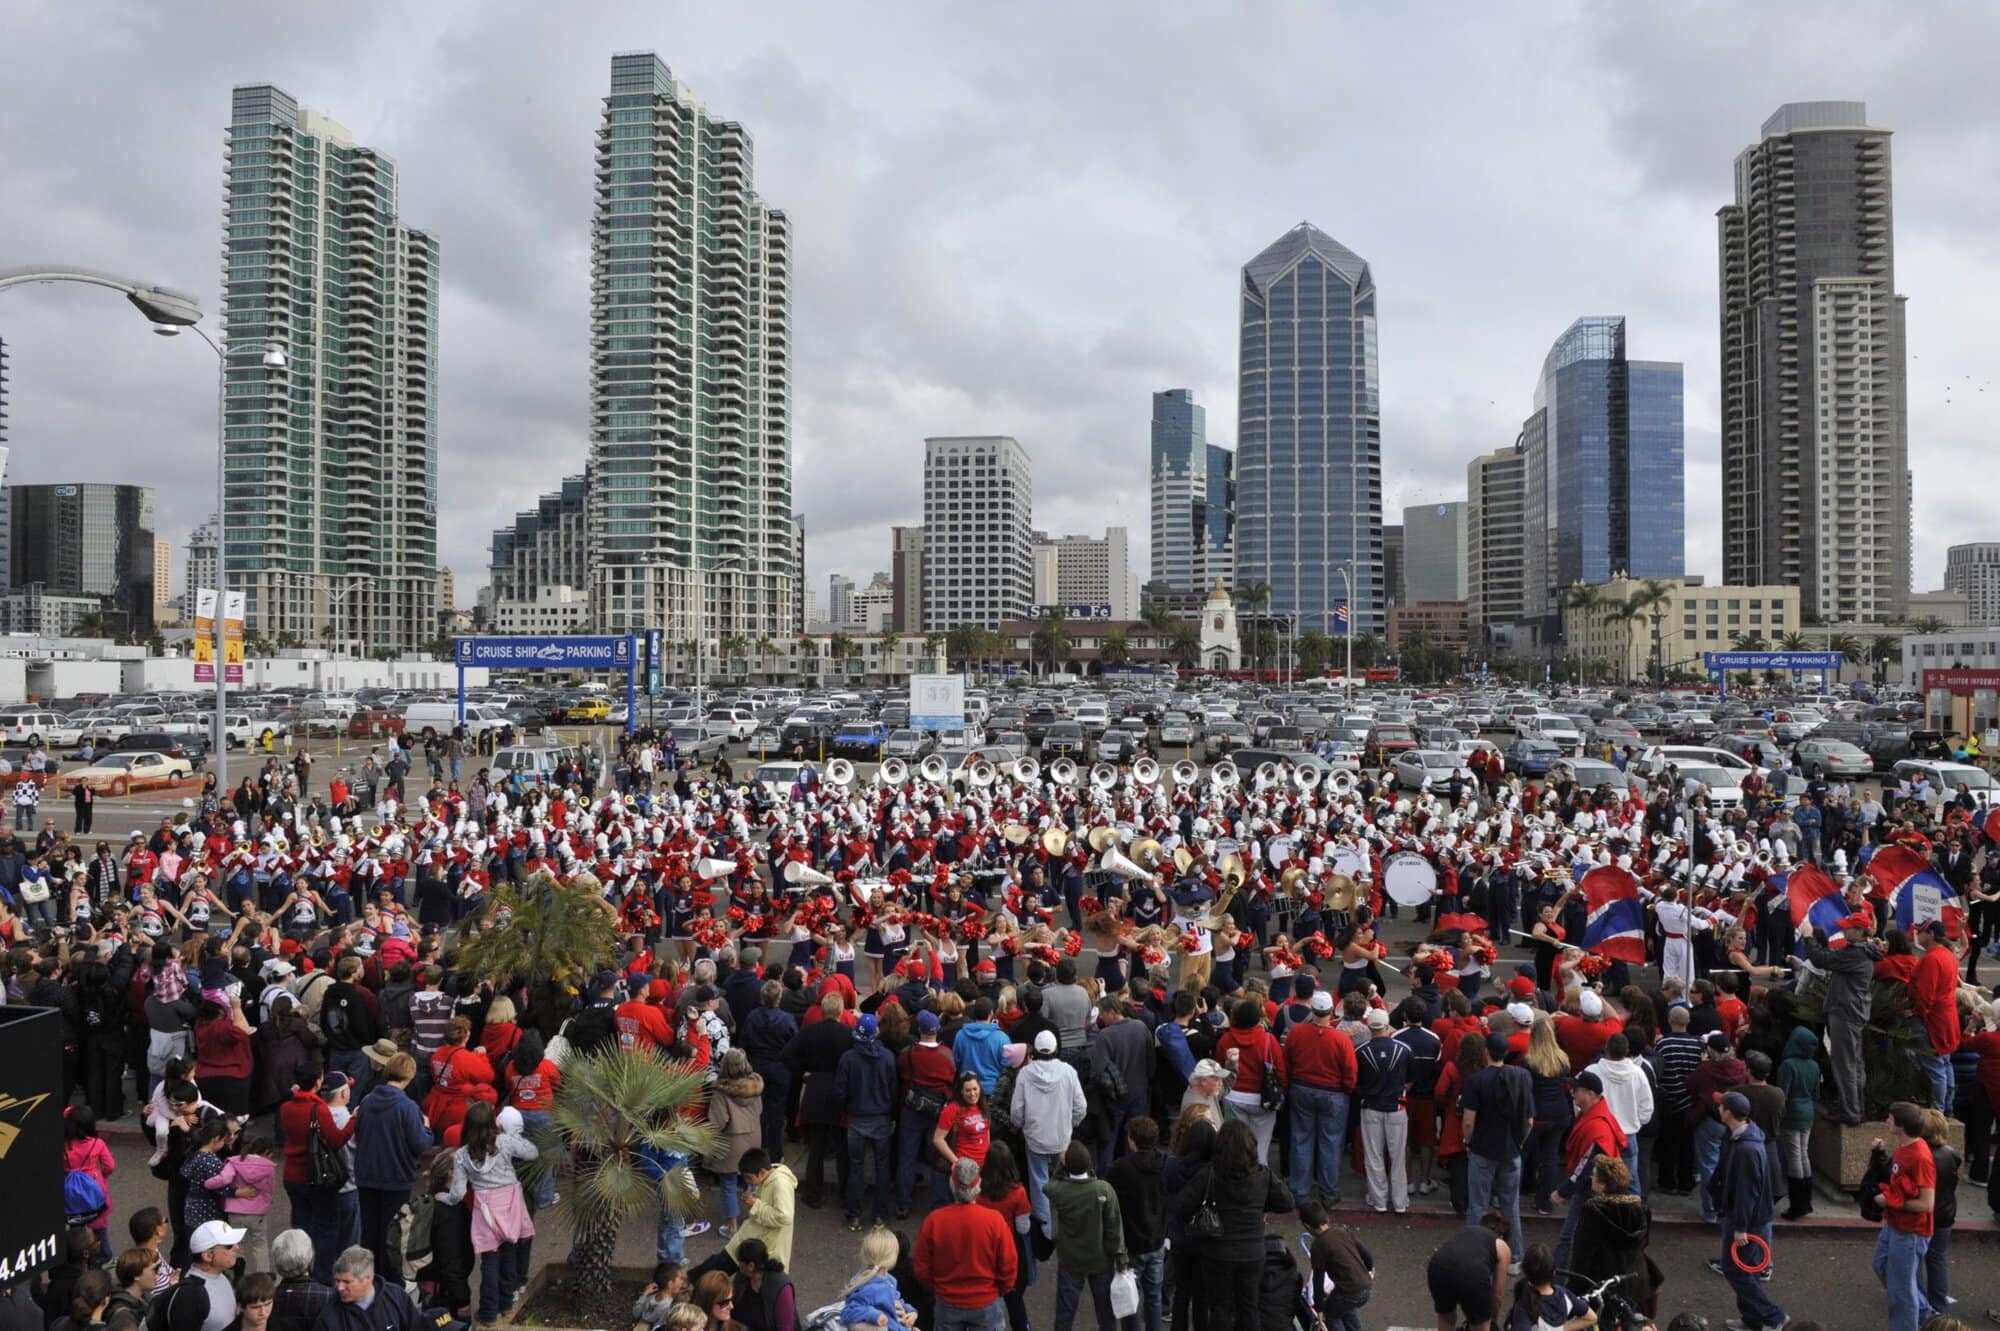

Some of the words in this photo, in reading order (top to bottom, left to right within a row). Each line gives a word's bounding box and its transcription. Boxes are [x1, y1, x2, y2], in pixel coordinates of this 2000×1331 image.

[1030, 605, 1081, 617] Sata
[1091, 605, 1109, 617] Fe
[462, 641, 471, 655] 5
[617, 640, 626, 654] 5
[652, 631, 659, 656] 5
[476, 646, 513, 658] CRUISE
[515, 646, 538, 658] SHIP
[567, 646, 612, 658] PARKING
[1720, 656, 1749, 664] CRUISE
[1750, 656, 1769, 664] SHIP
[1791, 656, 1827, 664] PARKING
[651, 673, 658, 690] P
